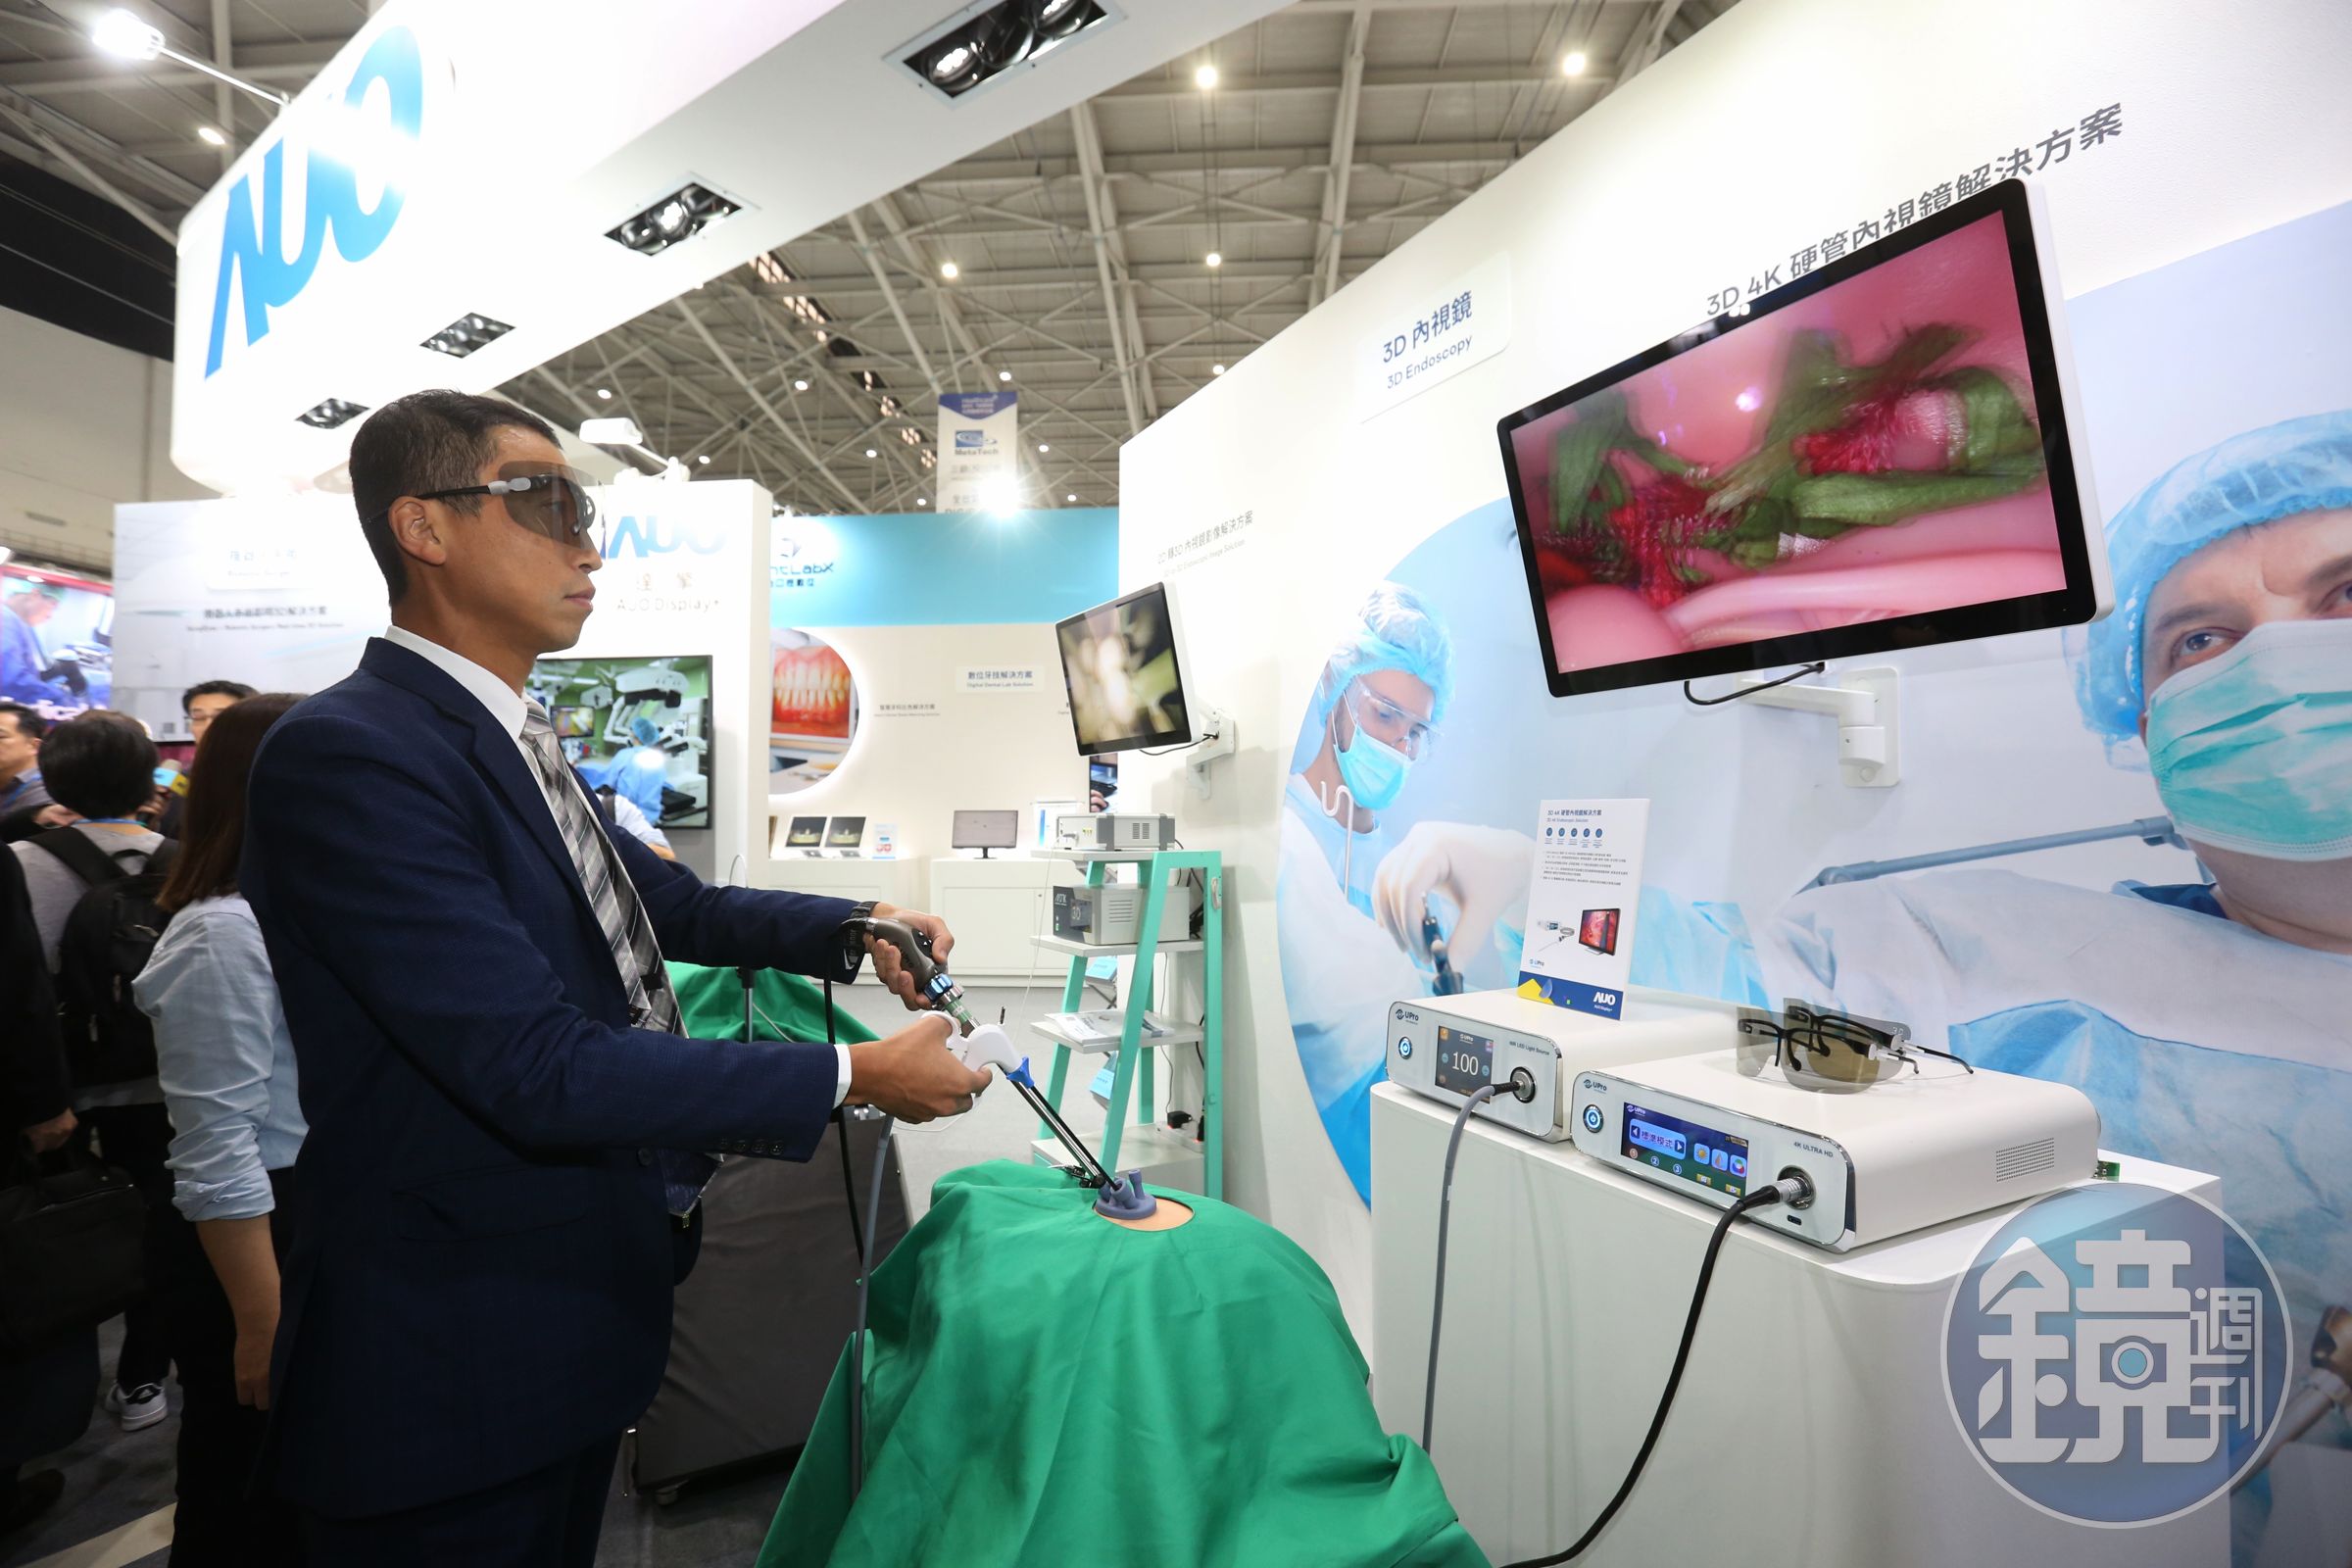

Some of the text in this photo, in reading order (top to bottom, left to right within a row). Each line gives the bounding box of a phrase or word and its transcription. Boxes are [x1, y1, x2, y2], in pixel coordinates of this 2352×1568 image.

[205, 24, 423, 380] AUO
[1706, 101, 2124, 316] 3D 4K 硬管內視鏡解決方案
[1383, 290, 1473, 365] 3D 內視鏡
[1387, 335, 1473, 390] 3D Endoscopy
[1593, 991, 1616, 1006] AUO
[1404, 1010, 1420, 1022] UPro
[1451, 1051, 1479, 1077] 100
[1592, 1081, 1608, 1092] UPro
[1641, 1130, 1675, 1151] 標準模式
[1793, 1141, 1835, 1158] 4K ULTRA HD
